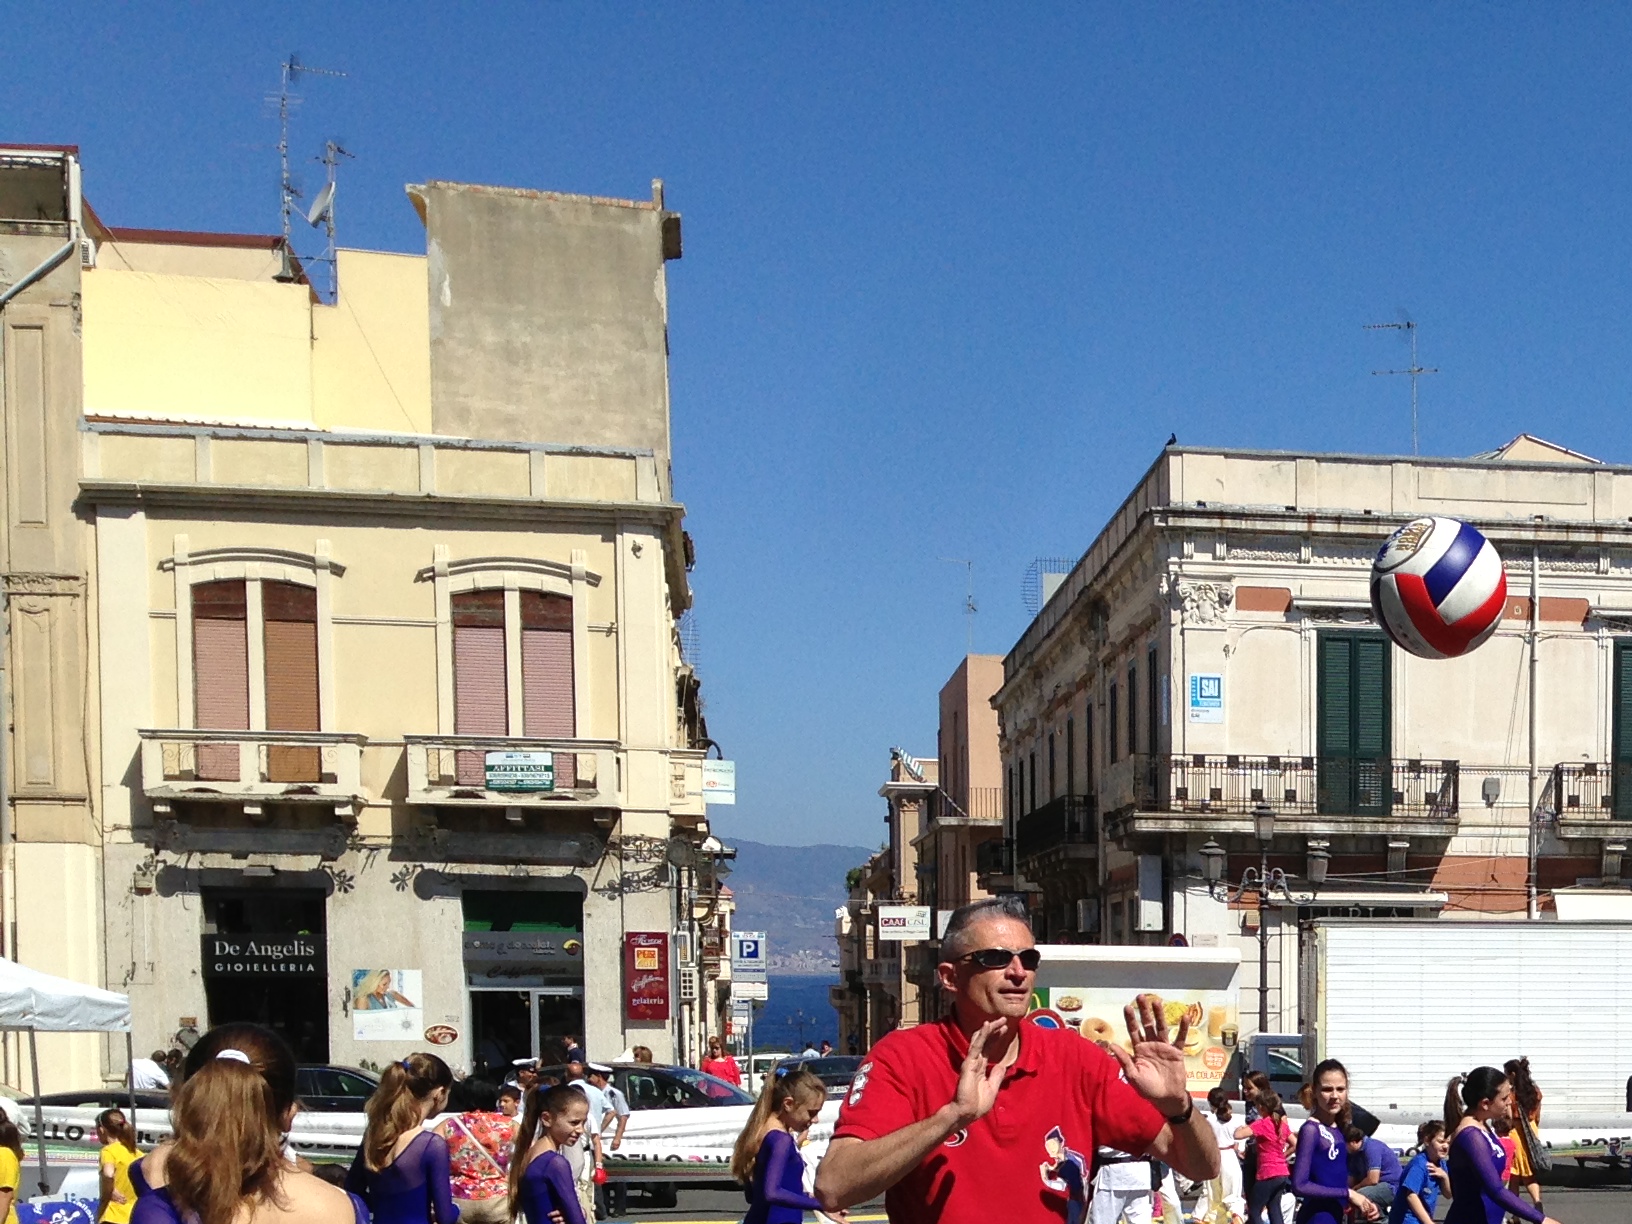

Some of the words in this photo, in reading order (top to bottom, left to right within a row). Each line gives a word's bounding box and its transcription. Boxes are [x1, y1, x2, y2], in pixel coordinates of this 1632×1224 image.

[1201, 679, 1219, 697] SAI
[214, 940, 241, 956] De
[244, 940, 315, 960] Angelis
[742, 941, 756, 957] P
[214, 962, 315, 972] GIOIELLERIA
